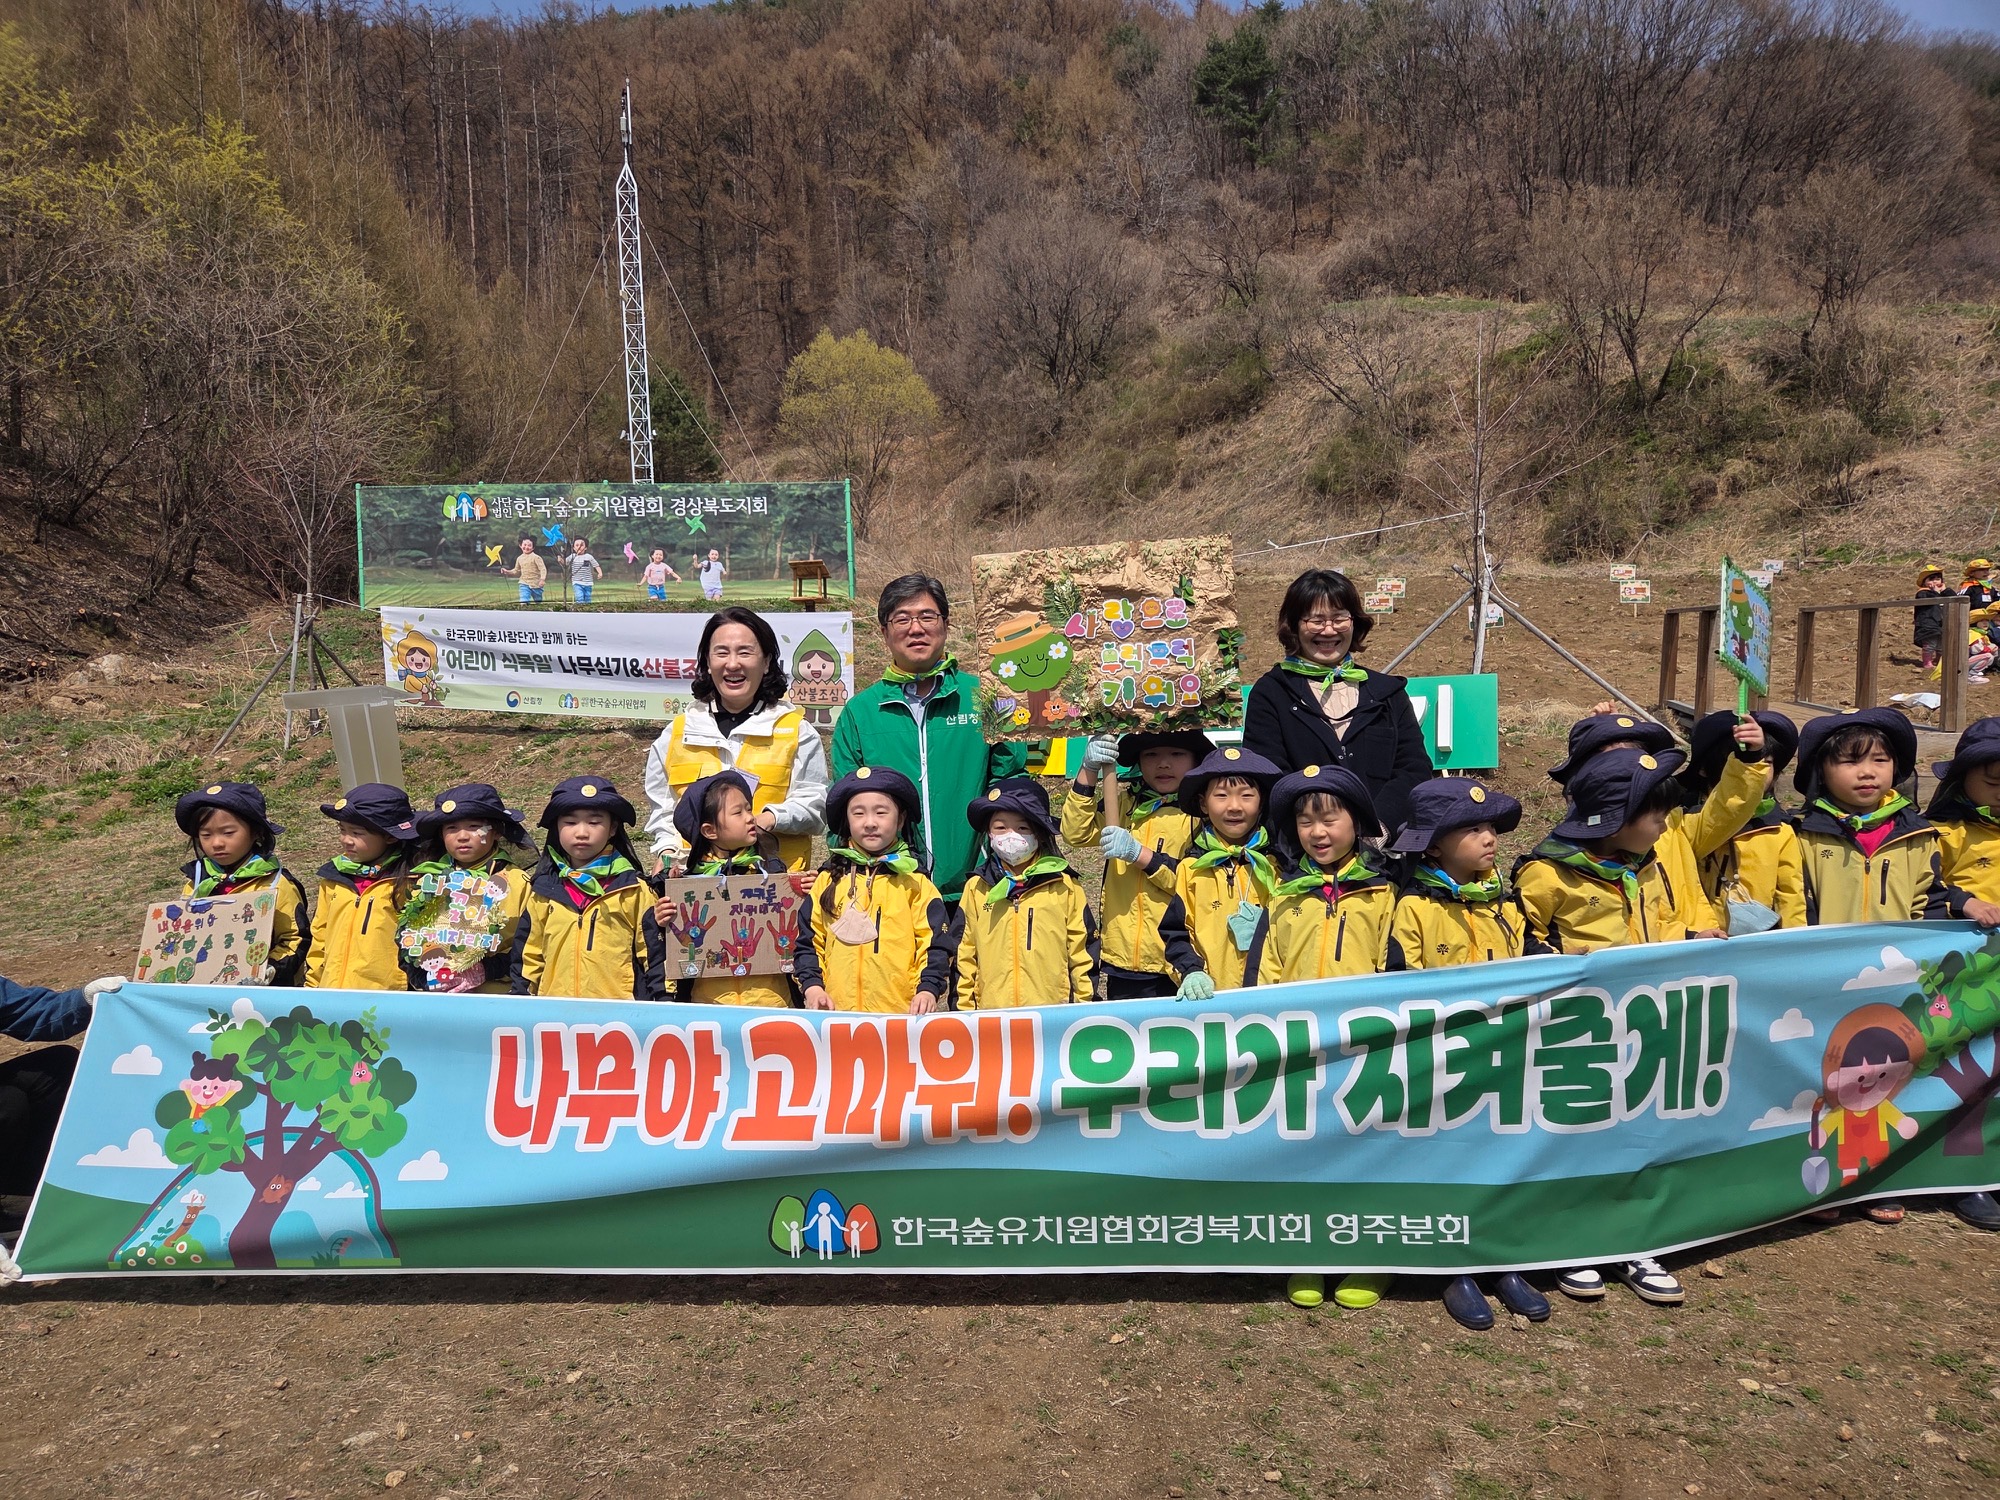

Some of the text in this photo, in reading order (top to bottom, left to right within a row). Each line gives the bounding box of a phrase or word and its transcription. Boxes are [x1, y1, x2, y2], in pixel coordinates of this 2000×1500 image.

[513, 496, 768, 517] 한국숲유치원협회 경상북도지회
[1064, 597, 1189, 640] 사랑으로
[446, 628, 588, 646] 한국유아숲사랑단과 함께 하는
[796, 688, 839, 702] 산불조심
[1100, 673, 1202, 709] 키워요
[589, 697, 647, 710] 한국숲유치원협회
[946, 713, 979, 726] 산림청
[486, 975, 1737, 1153] 나무야 고마워! 우리가 지켜줄게!
[891, 1213, 1471, 1246] 한국숲유치원협회경북지회 영주분회
